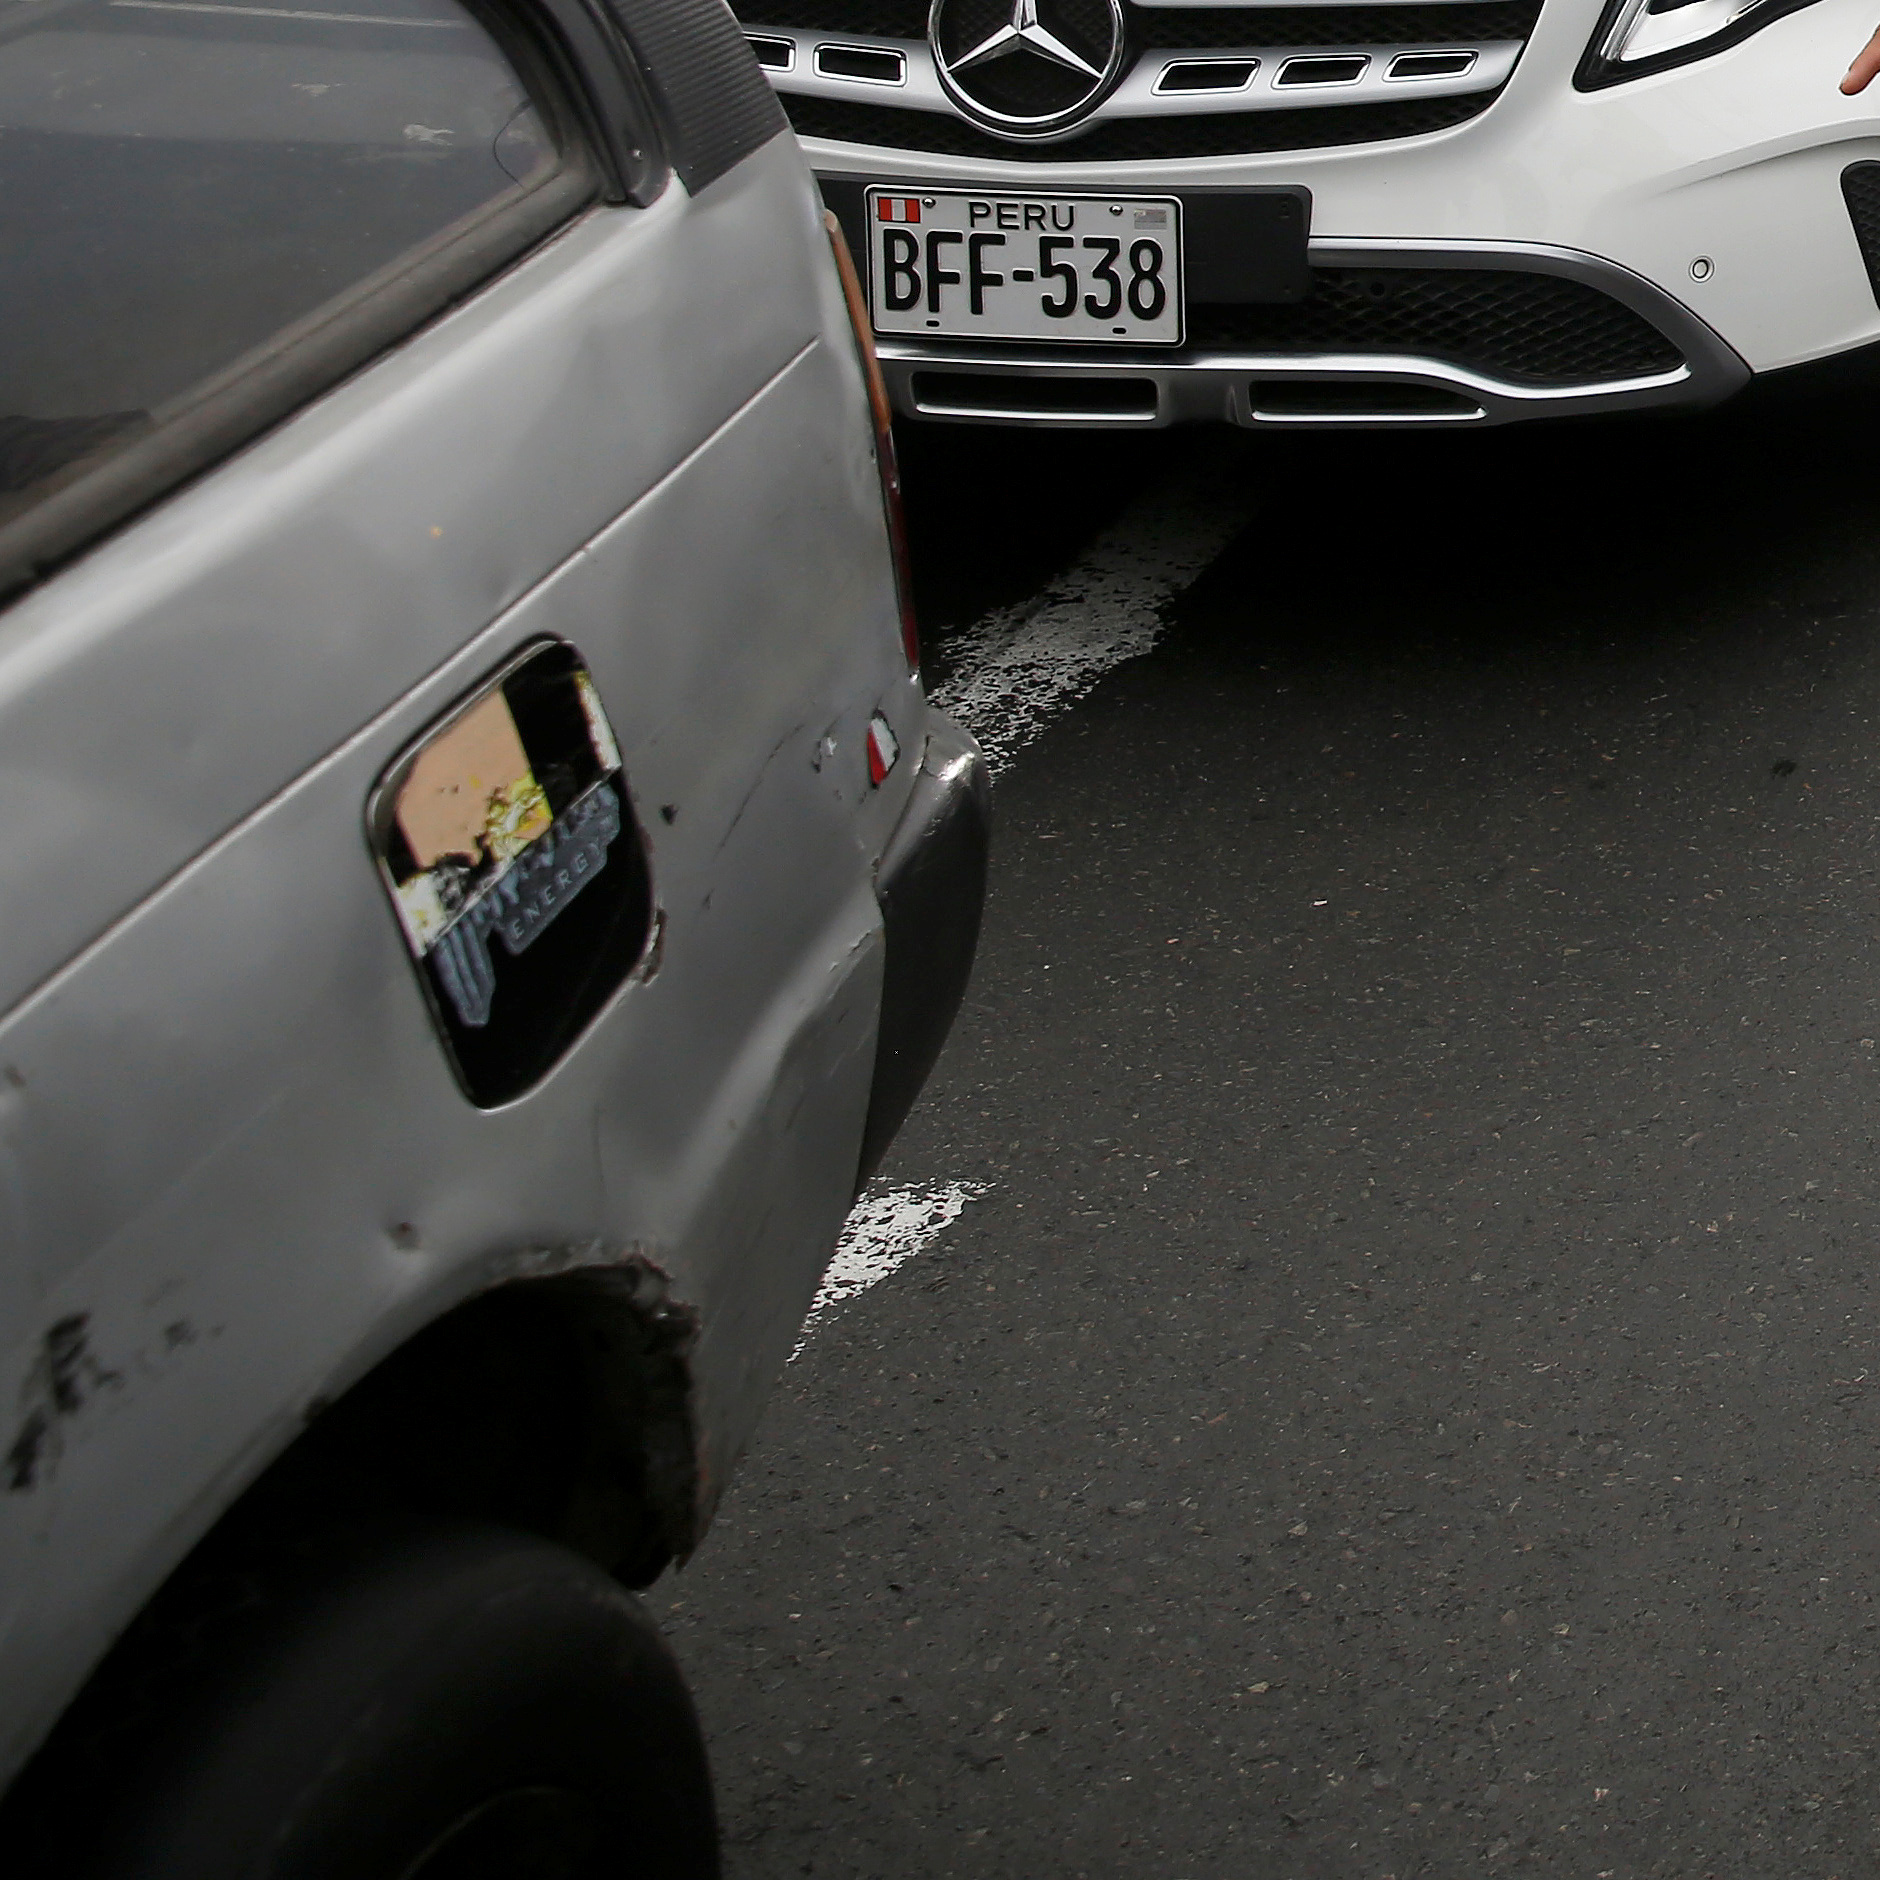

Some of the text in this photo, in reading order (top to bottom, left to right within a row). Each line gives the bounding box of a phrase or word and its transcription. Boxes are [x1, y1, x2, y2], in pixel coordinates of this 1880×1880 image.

[969, 201, 1076, 231] PERU
[882, 228, 1167, 321] BFF-538
[511, 840, 602, 941] ENERGY
